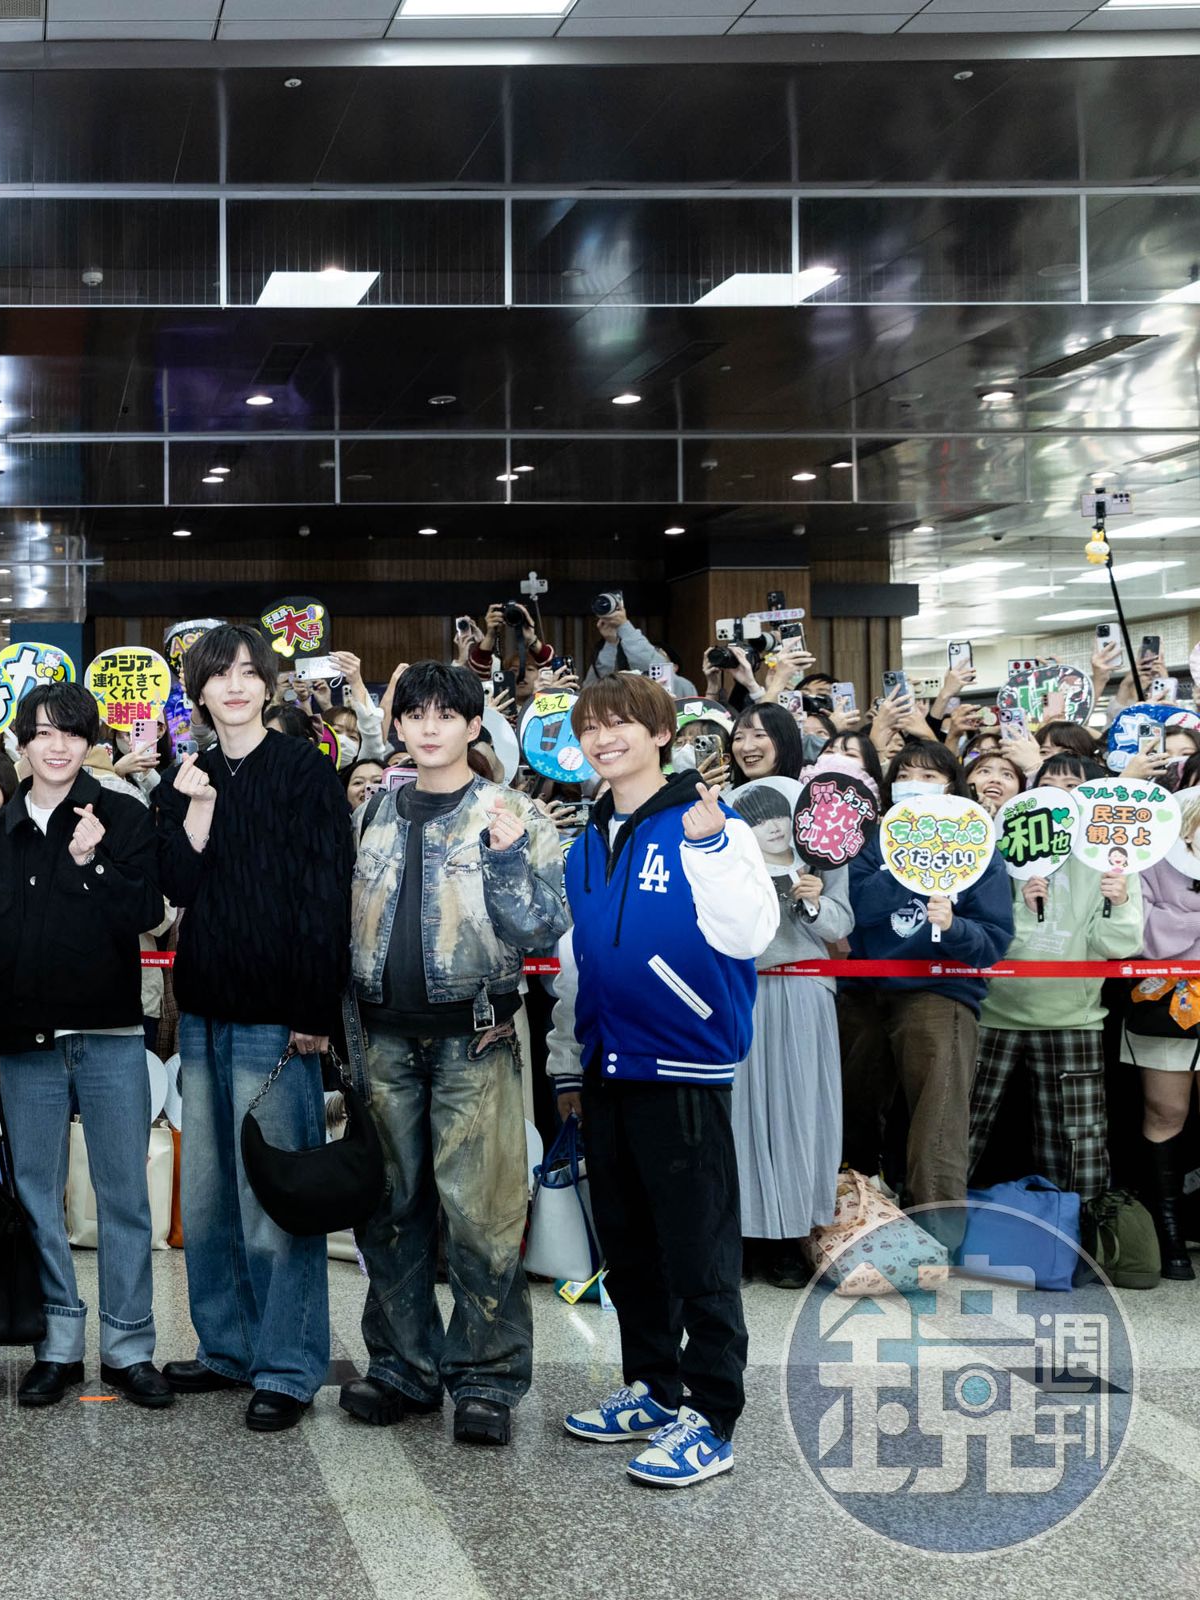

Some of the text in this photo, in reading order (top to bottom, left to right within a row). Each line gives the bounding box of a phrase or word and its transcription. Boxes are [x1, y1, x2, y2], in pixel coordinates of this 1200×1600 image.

[101, 654, 153, 671] アジア
[93, 673, 162, 687] 連れてきて
[109, 686, 148, 700] くれて
[1078, 785, 1166, 803] マルちゃん
[888, 816, 987, 844] ちゅきちゅき
[1086, 825, 1151, 846] 観るよ
[638, 843, 670, 893] LA
[892, 847, 975, 870] ください
